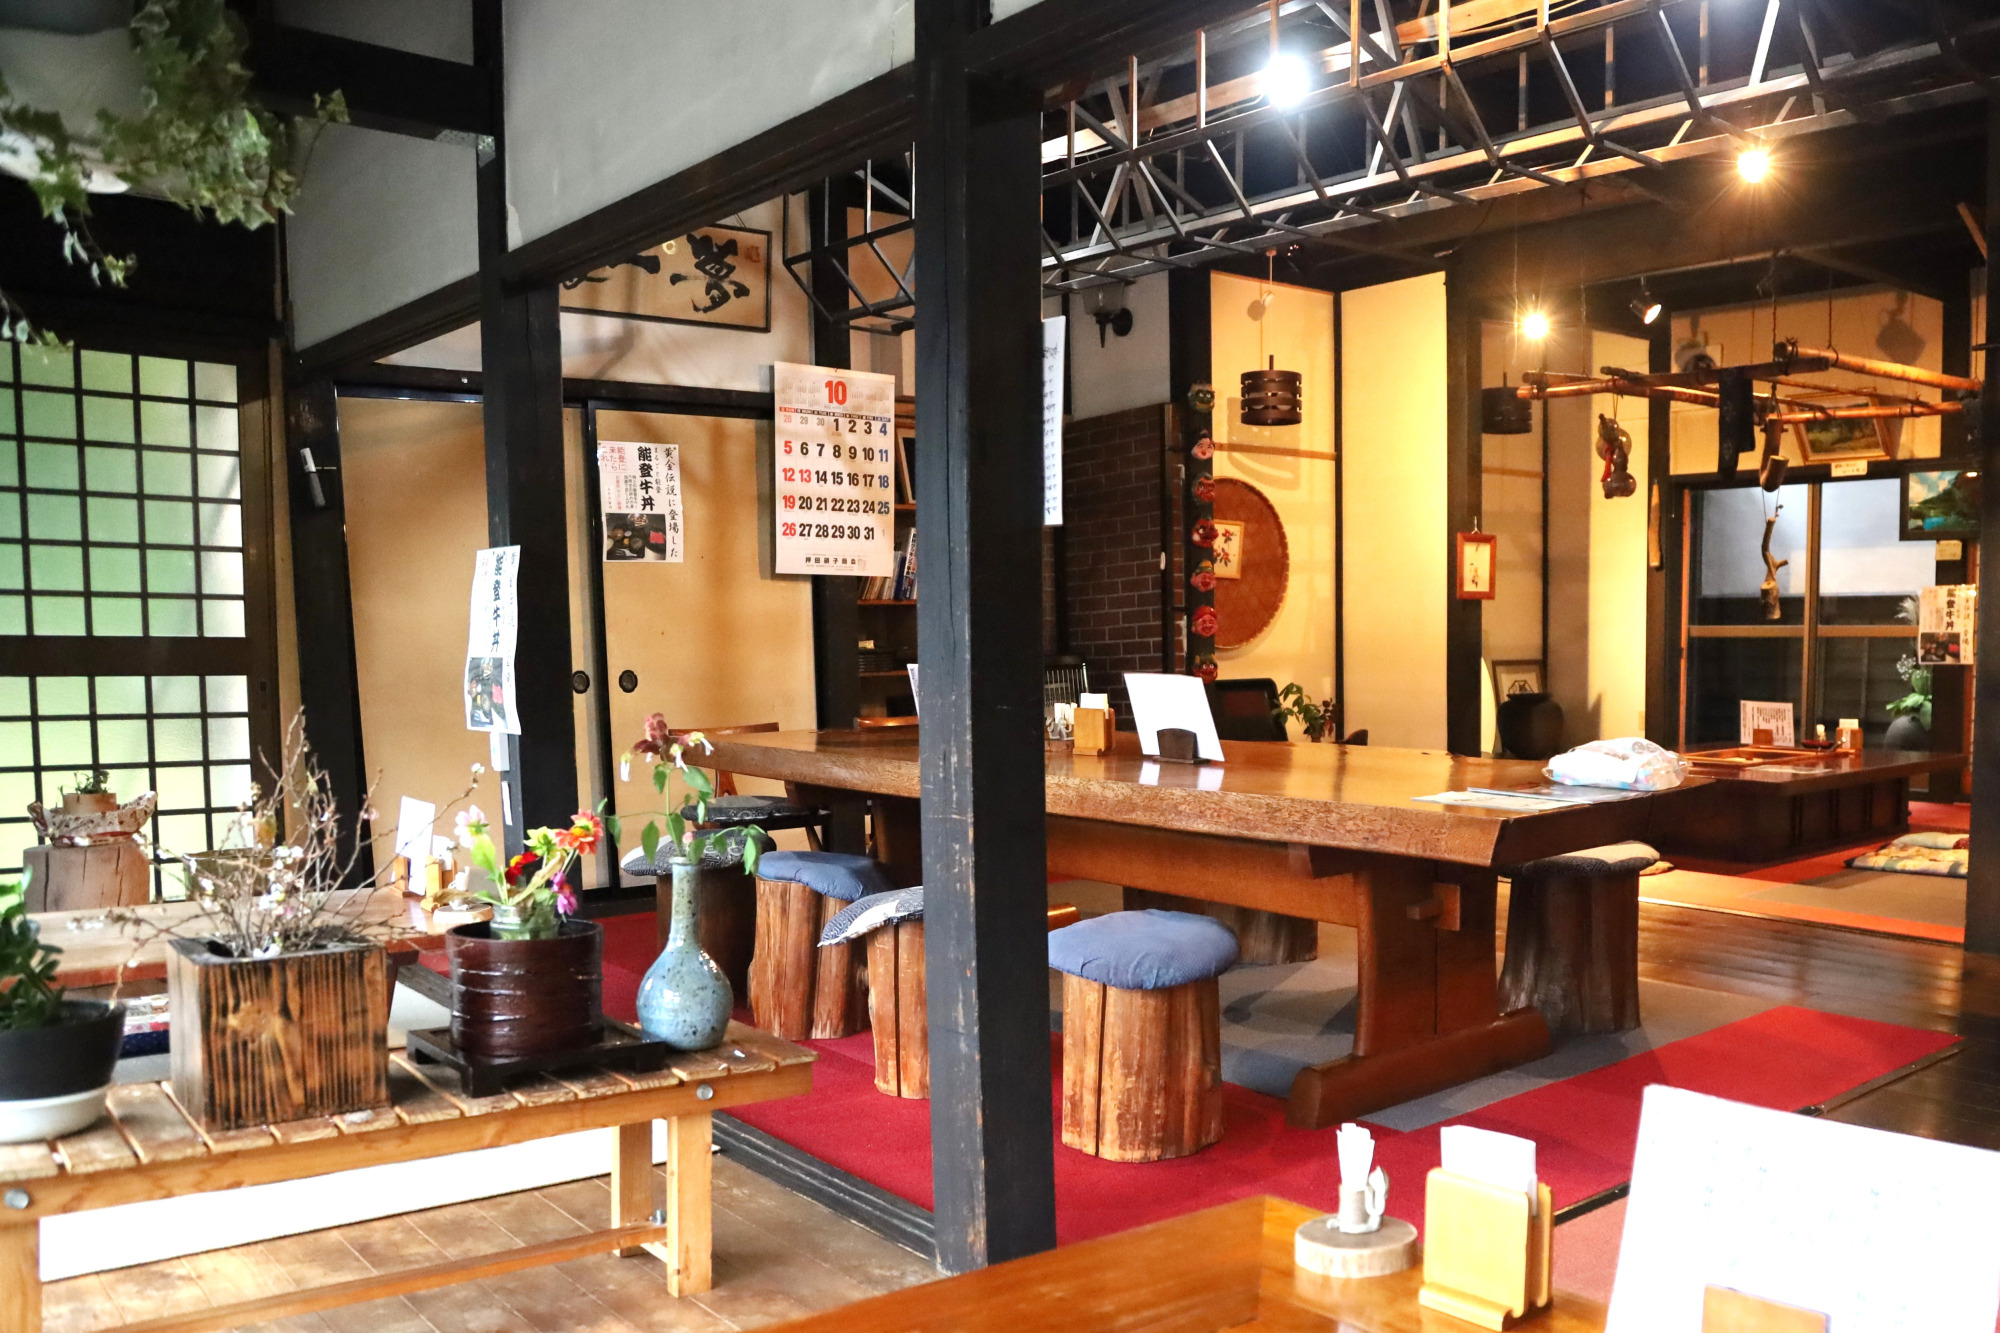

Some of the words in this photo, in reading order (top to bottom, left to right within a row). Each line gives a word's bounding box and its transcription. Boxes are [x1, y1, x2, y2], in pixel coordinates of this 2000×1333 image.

[825, 380, 847, 405] 10
[784, 415, 793, 424] 28
[800, 416, 809, 425] 29
[816, 417, 825, 427] 30
[833, 418, 839, 431] 1
[848, 420, 856, 433] 2
[863, 421, 872, 434] 3
[879, 423, 887, 436] 4
[783, 441, 792, 454] 5
[800, 442, 808, 455] 6
[816, 443, 825, 456] 7
[832, 444, 841, 458] 8
[848, 446, 857, 460] 9
[862, 448, 874, 461] 10
[878, 449, 888, 462] 11
[637, 445, 655, 511] 能登牛丼
[782, 468, 795, 481] 12
[798, 469, 811, 483] 13
[814, 471, 827, 484] 14
[830, 472, 843, 485] 15
[846, 473, 859, 486] 16
[862, 474, 874, 487] 17
[877, 475, 889, 488] 18
[664, 447, 679, 558] 黄金伝説に登場した
[782, 495, 795, 509] 19
[798, 496, 812, 510] 20
[815, 497, 827, 511] 21
[830, 498, 844, 512] 22
[846, 499, 860, 513] 23
[862, 500, 875, 514] 24
[877, 501, 889, 514] 25
[782, 523, 796, 536] 26
[798, 523, 812, 537] 27
[815, 524, 829, 538] 28
[831, 525, 844, 538] 29
[847, 526, 860, 539] 30
[863, 527, 874, 540] 31
